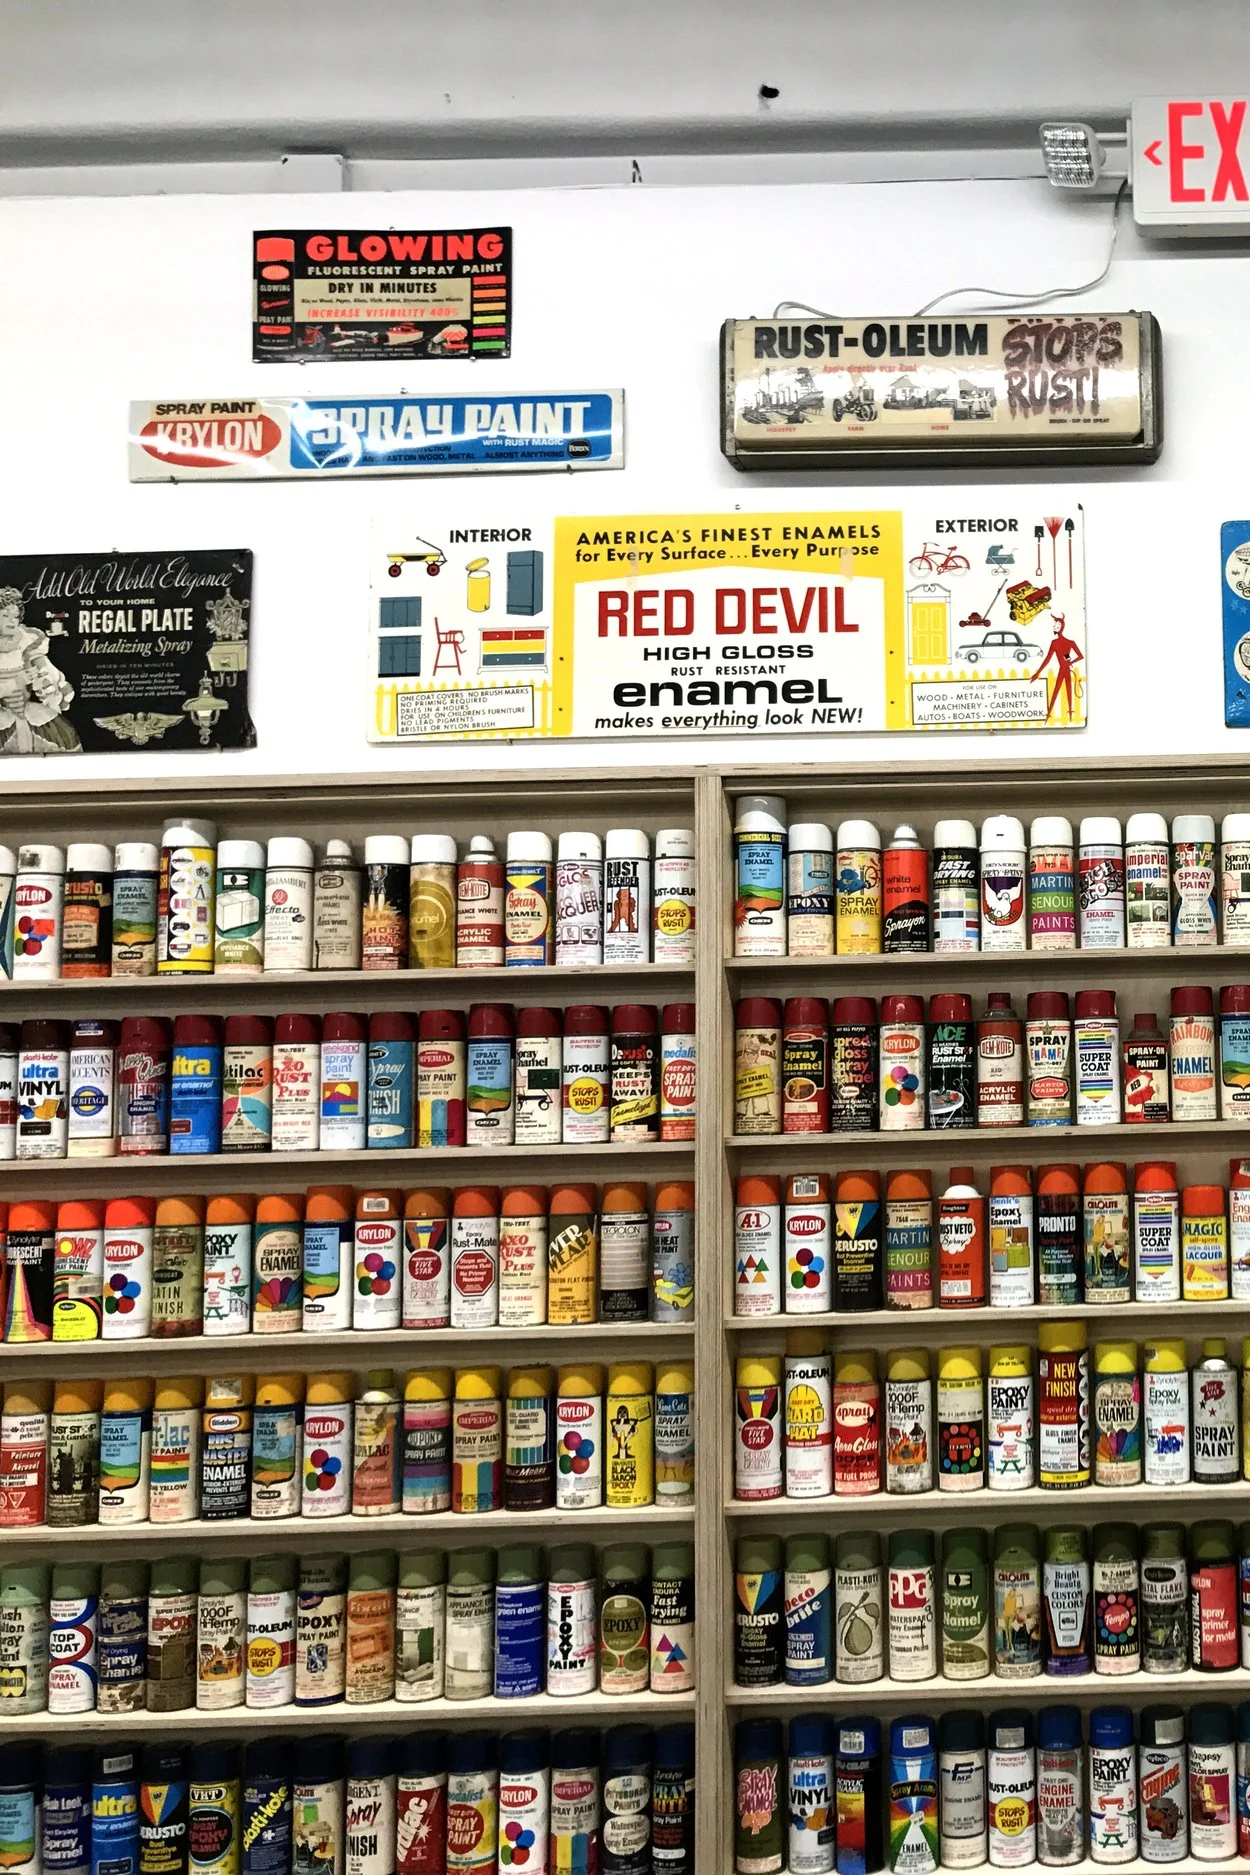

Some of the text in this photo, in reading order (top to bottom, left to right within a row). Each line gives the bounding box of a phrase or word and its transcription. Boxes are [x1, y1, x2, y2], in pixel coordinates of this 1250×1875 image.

[306, 233, 504, 262] GLOWING
[308, 263, 503, 276] FLUORESCENT SPRAY PAINT
[328, 282, 437, 294] DRY IN MINUTES
[307, 308, 360, 318] INCREASE
[366, 307, 426, 318] VISIBILITY
[754, 323, 988, 359] RUST-OLEUM
[1002, 322, 1123, 368] STOPS
[1005, 368, 1100, 419] RUST!
[156, 400, 255, 417] SPRAY PAINT
[311, 401, 591, 446] SPRAY PAINT
[156, 417, 265, 454] KRYLON
[482, 437, 564, 447] WITH RUST MAGIC
[936, 519, 1018, 533] EXTERIOR
[450, 529, 532, 544] INTERIOR
[577, 524, 881, 545] AMERICA'S FINEST ENAMELS
[576, 550, 602, 562] for
[607, 548, 653, 563] Every
[751, 544, 802, 559] Every
[806, 543, 880, 558] Purpose
[22, 556, 234, 603] Add Old World Elegance
[598, 586, 859, 637] RED DEVIL
[78, 608, 193, 633] REGAL PLATE
[78, 636, 193, 656] Metalizing Spray
[644, 644, 814, 661] HIGH GLOSS
[671, 665, 786, 676] RUST RESISTANT
[451, 697, 487, 705] REQUIRED
[956, 692, 985, 700] METAL
[993, 690, 1044, 699] FURNITURE
[933, 701, 1028, 710] MACHINERY CABINETS
[595, 708, 864, 730] makes everything look NEW!
[953, 712, 980, 720] BOATS
[988, 710, 1045, 718] WOODWORK
[606, 861, 638, 877] RUST
[1178, 871, 1212, 881] SPRAY
[1032, 875, 1074, 888] MARTIN
[1179, 880, 1210, 889] PAINT
[1032, 895, 1074, 909] SENOUR
[1032, 917, 1075, 928] PAINTS
[1079, 1052, 1112, 1063] SUPER
[22, 1064, 59, 1079] ultra
[1080, 1062, 1110, 1072] COAT
[19, 1081, 63, 1095] VINYL
[1039, 1217, 1076, 1232] PRONTO
[358, 1229, 392, 1239] KRYLON
[1054, 1363, 1075, 1378] NEW
[1046, 1381, 1076, 1396] FINISH
[1196, 1426, 1235, 1441] SPRAY
[1195, 1440, 1235, 1457] PAINT
[53, 1633, 75, 1642] TOP
[51, 1643, 80, 1652] COAT
